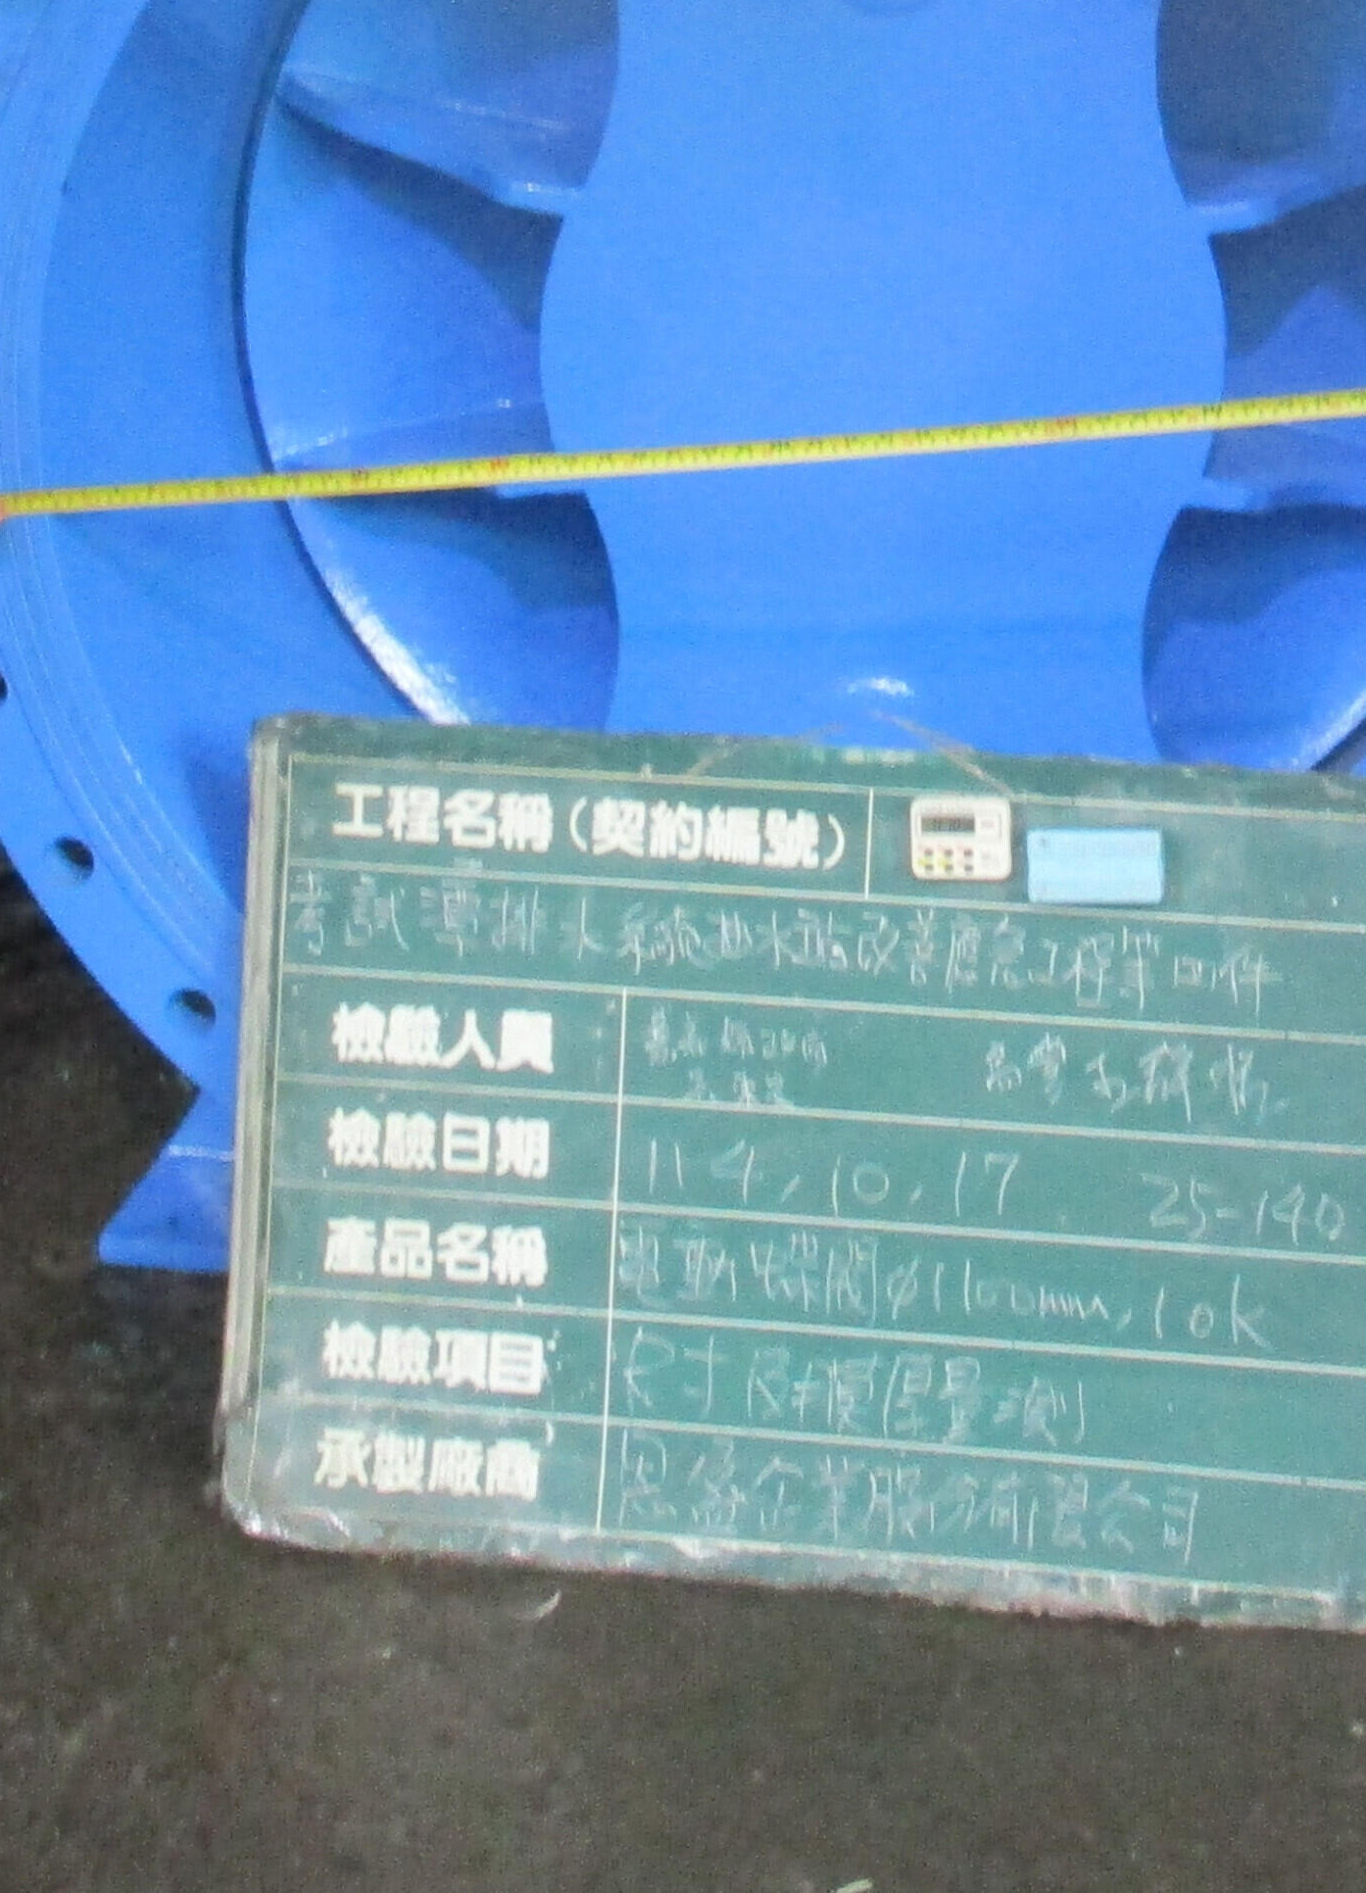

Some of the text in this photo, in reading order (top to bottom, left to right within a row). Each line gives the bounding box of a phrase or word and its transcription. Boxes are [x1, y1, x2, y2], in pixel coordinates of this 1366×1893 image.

[331, 1001, 554, 1074] 檢驗人員
[328, 1106, 550, 1180] 檢驗日期
[323, 1215, 548, 1287] 產品名稱
[321, 1319, 547, 1395] 檢驗項目
[314, 1425, 540, 1502] 承製廠商
